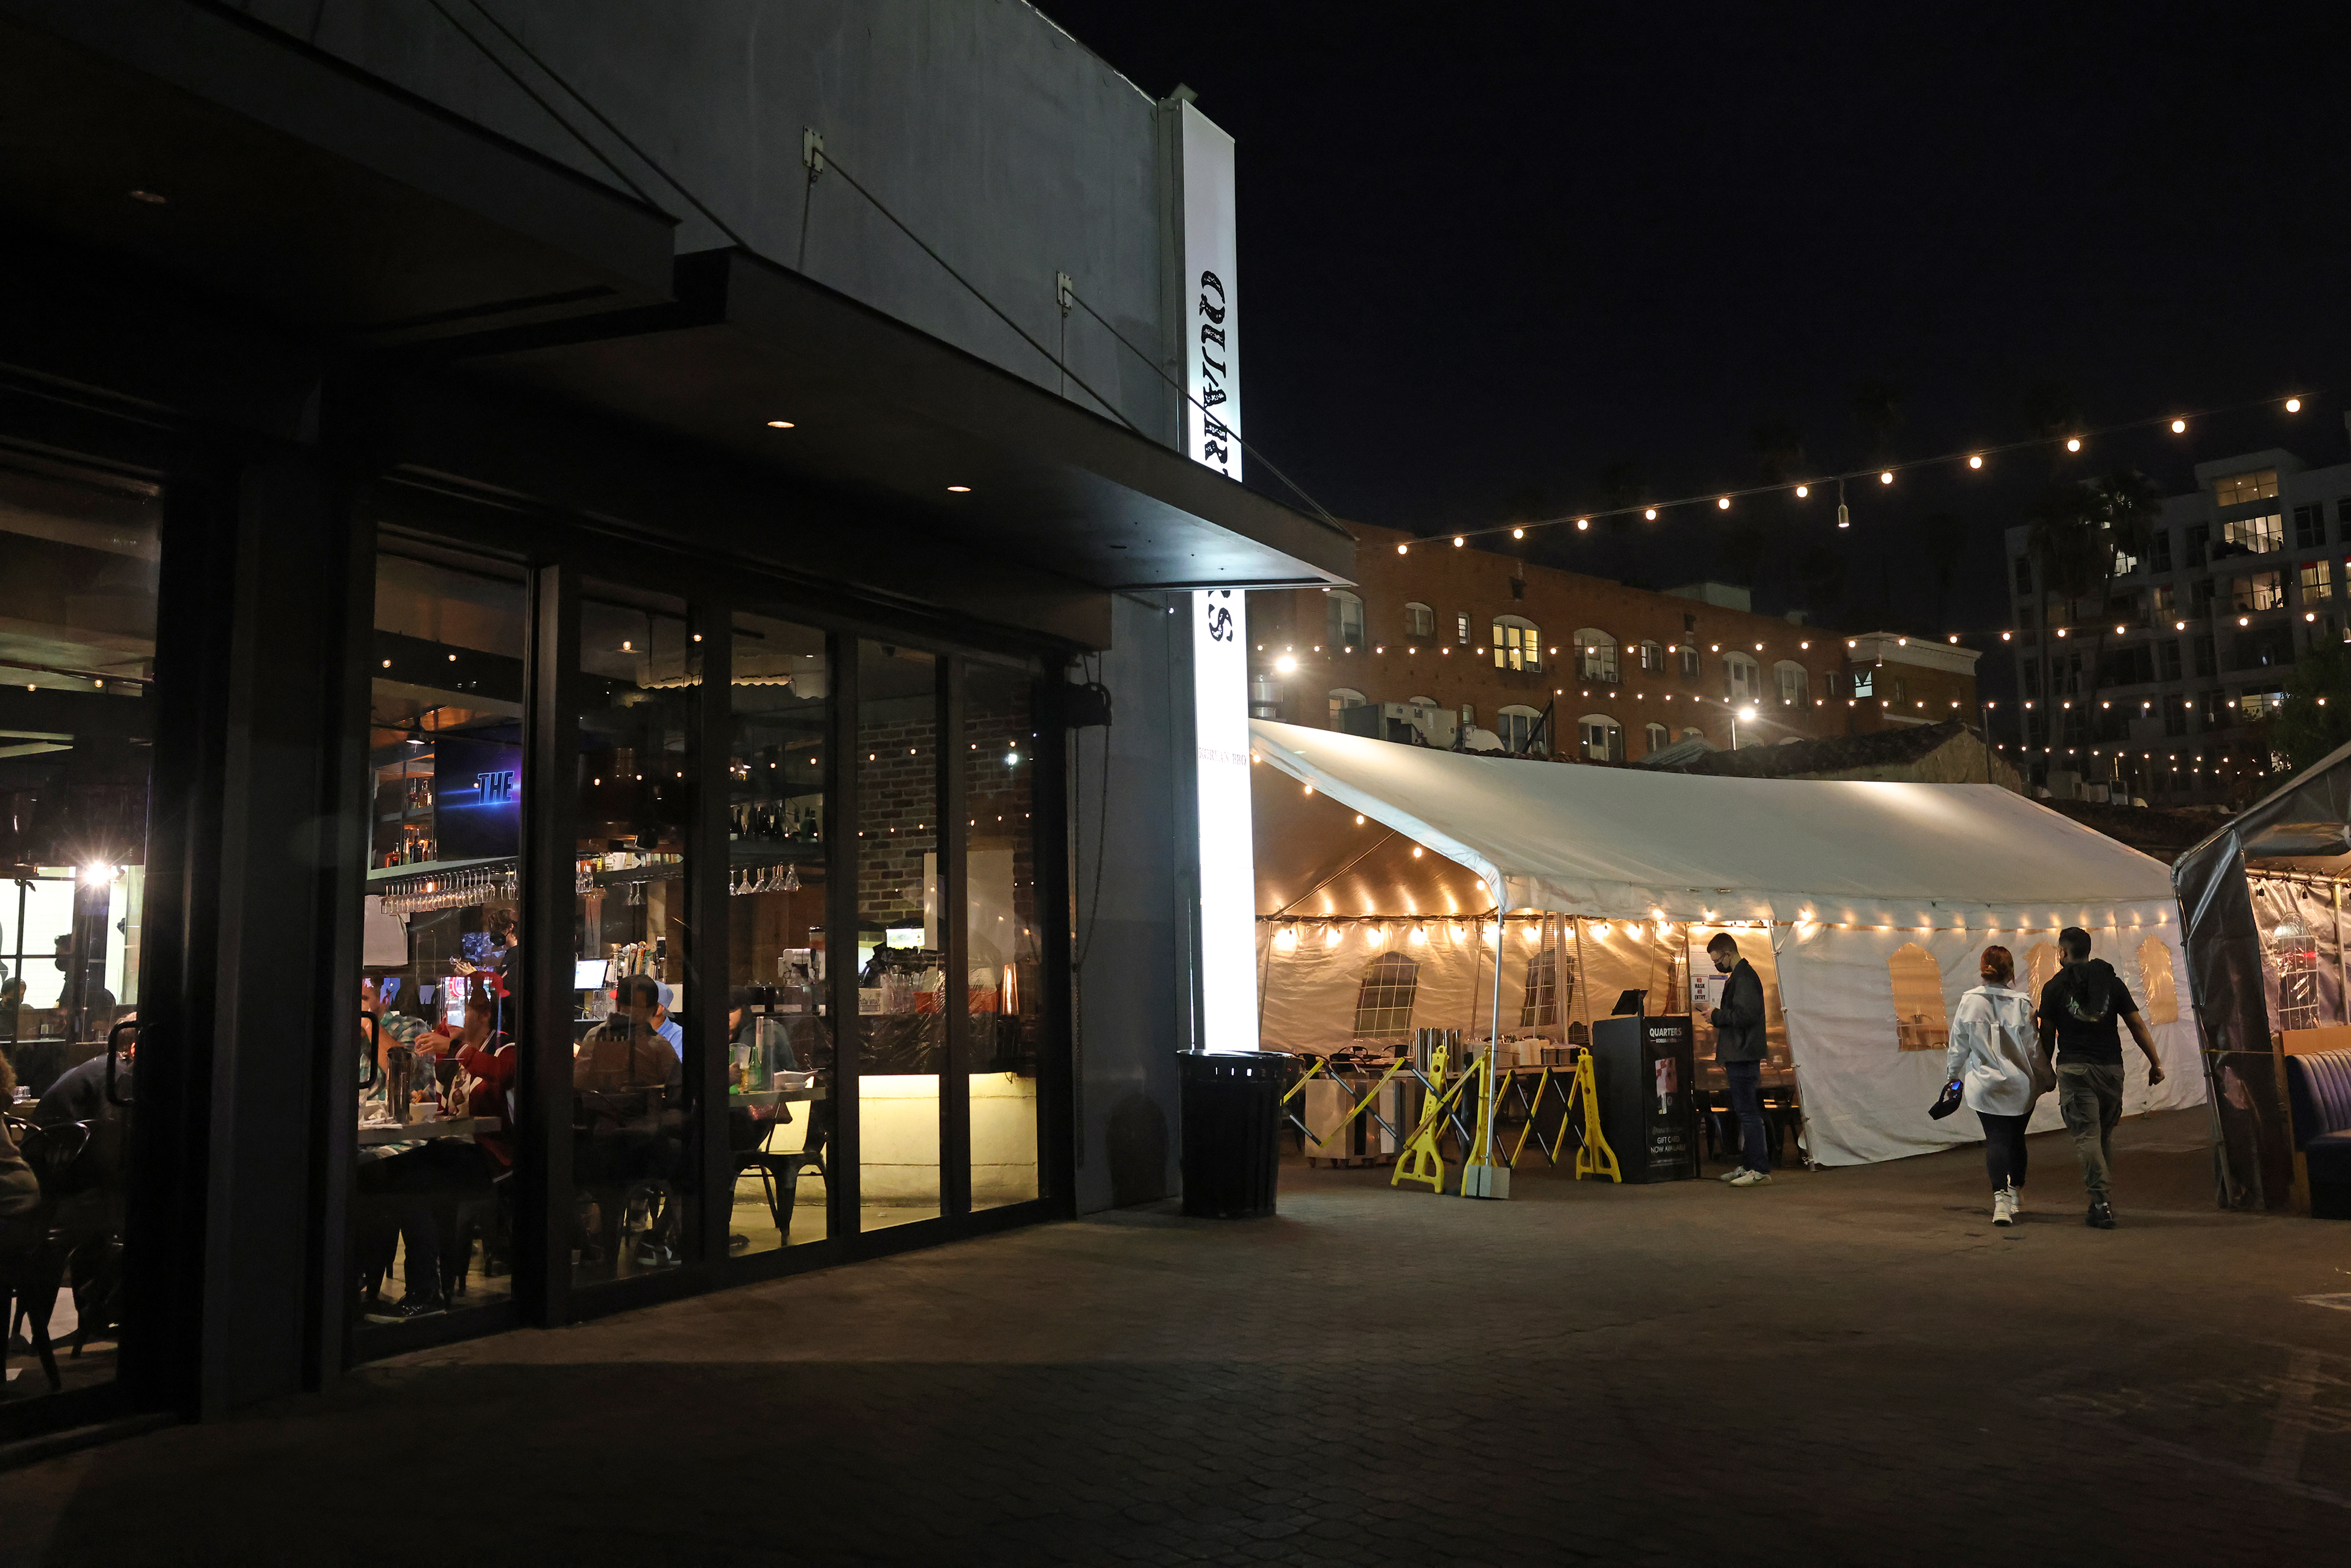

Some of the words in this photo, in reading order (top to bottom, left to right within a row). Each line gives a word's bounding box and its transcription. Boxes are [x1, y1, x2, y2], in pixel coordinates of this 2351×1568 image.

[1232, 753, 1247, 767] BBQ
[477, 770, 514, 805] THE
[1649, 1027, 1682, 1037] QUARTERS
